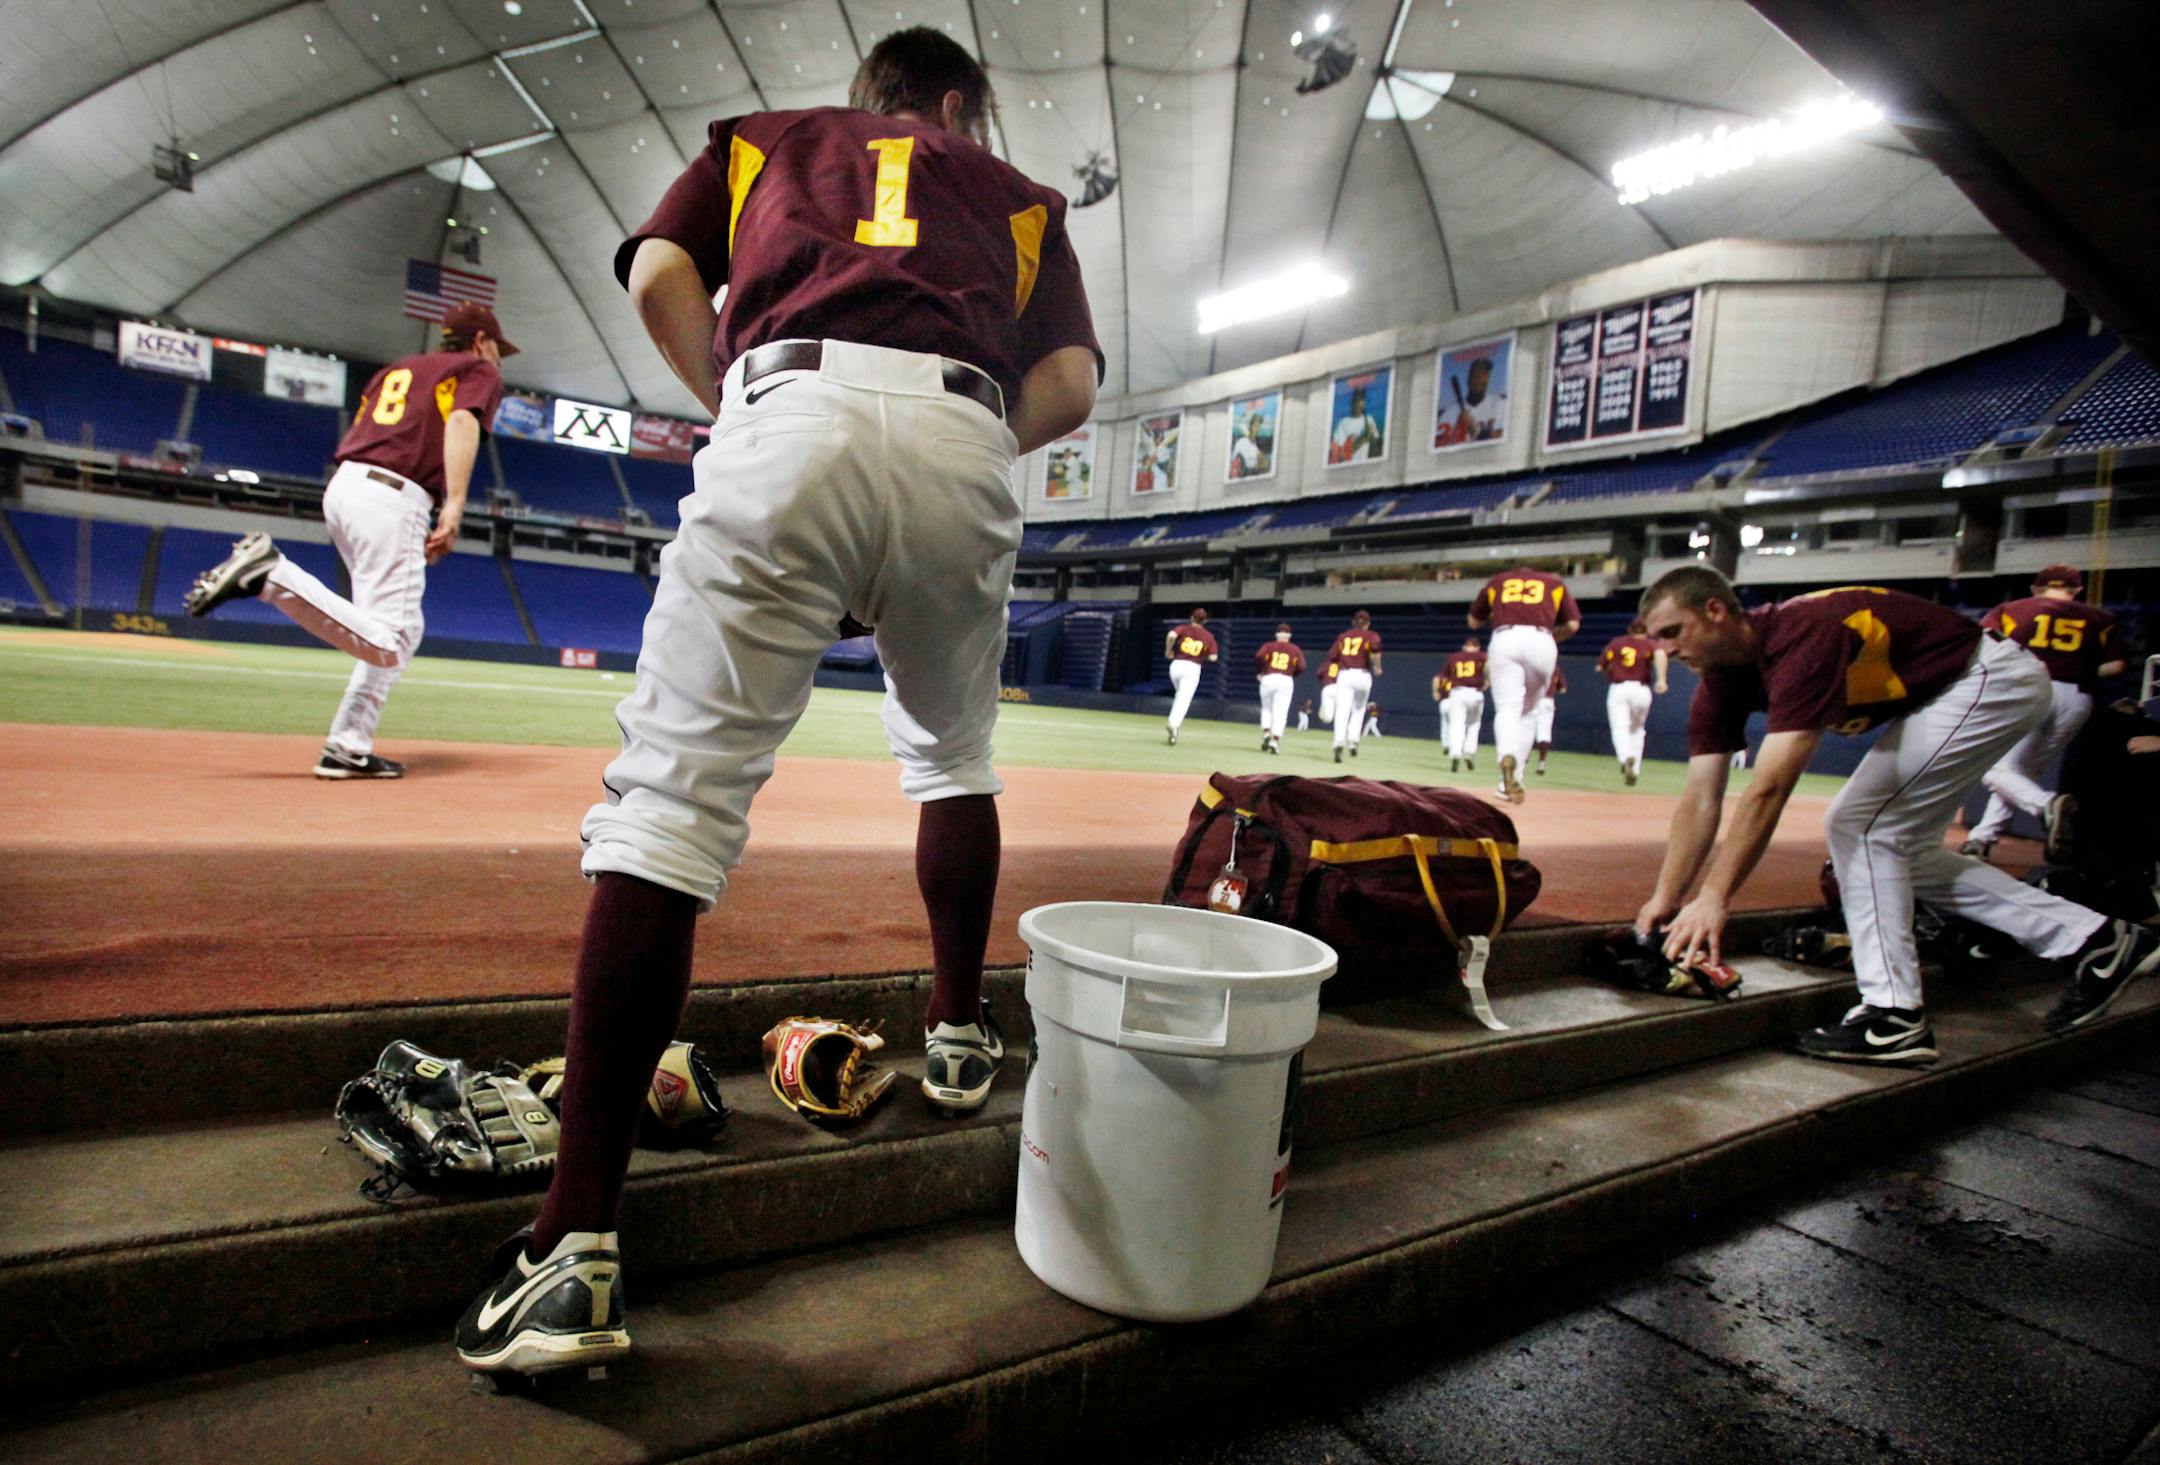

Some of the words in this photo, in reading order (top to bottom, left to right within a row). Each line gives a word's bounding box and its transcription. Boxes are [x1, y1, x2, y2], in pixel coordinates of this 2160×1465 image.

[854, 136, 918, 247] 1
[372, 368, 413, 425] 8
[555, 407, 624, 448] M
[1501, 579, 1545, 604] 23
[2028, 613, 2086, 652] 15
[1180, 636, 1203, 656] 20
[1342, 637, 1363, 655] 17
[1621, 646, 1636, 667] 3
[1270, 651, 1290, 670] 12
[1455, 661, 1476, 678] 13
